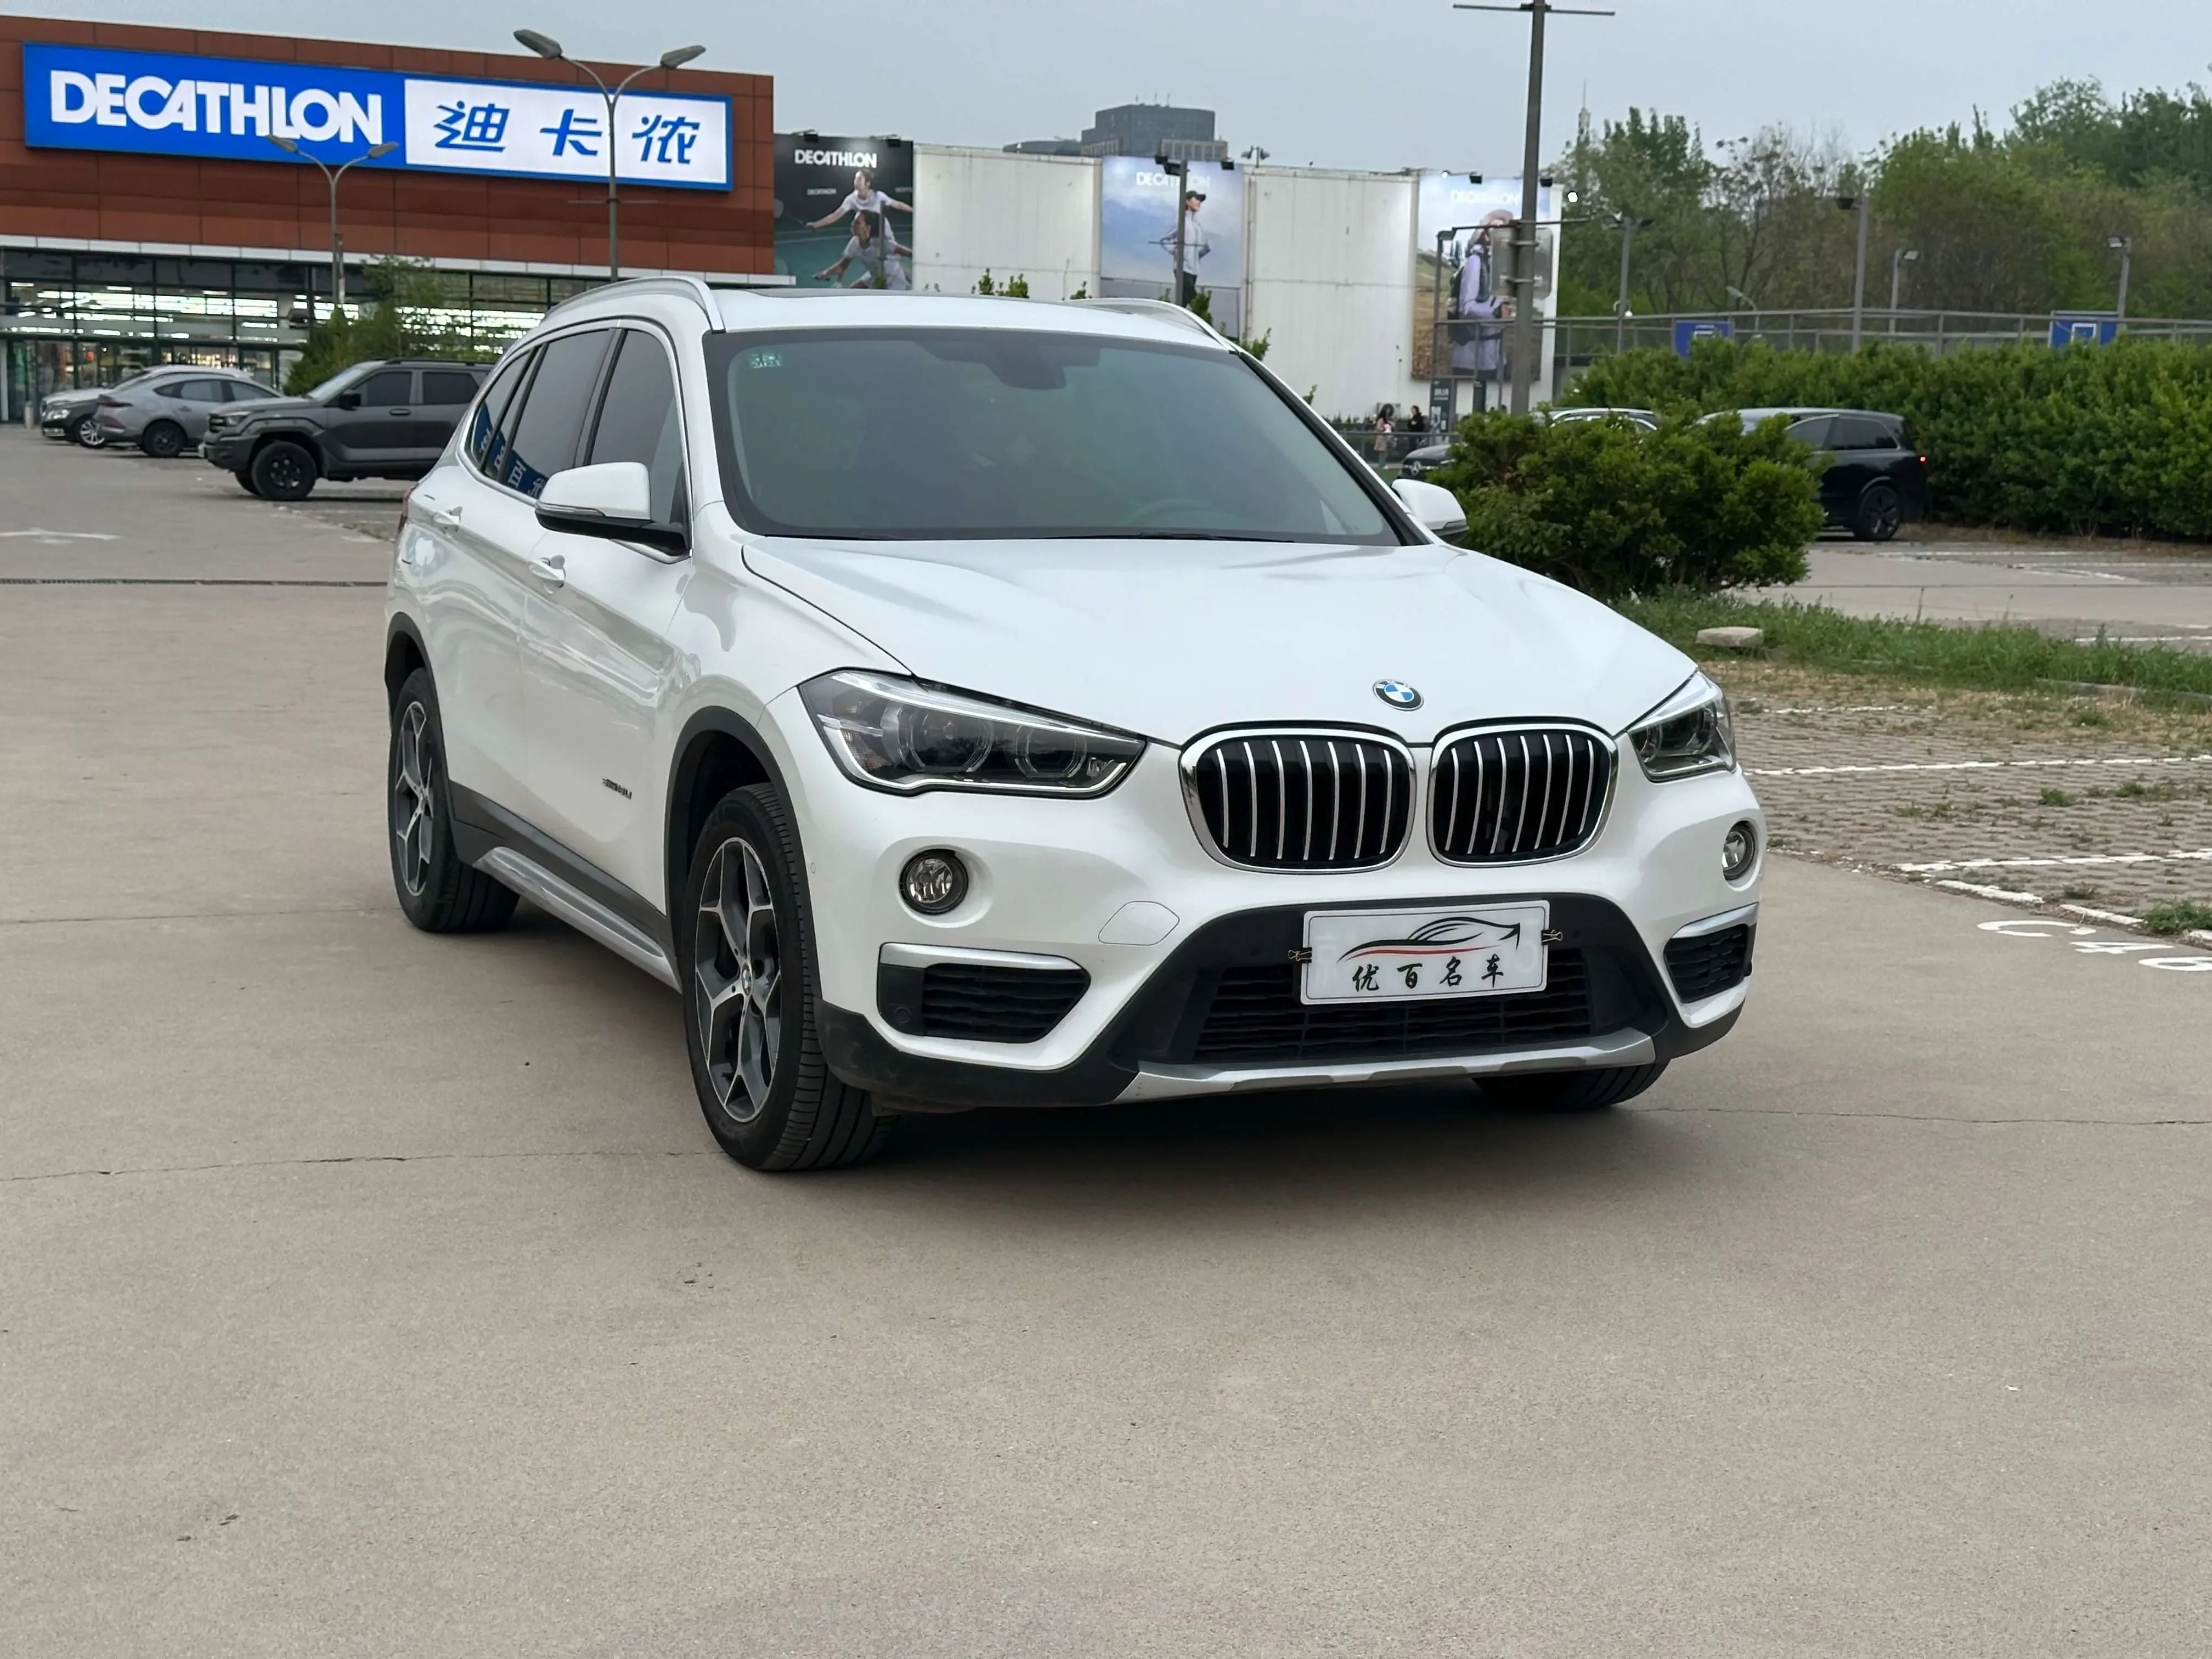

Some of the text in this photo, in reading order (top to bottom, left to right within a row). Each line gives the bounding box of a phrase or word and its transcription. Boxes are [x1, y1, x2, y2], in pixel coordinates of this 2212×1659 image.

[50, 70, 382, 145] DECATHLON
[434, 100, 700, 164] 迪卡侬
[794, 149, 877, 168] DECATHLON
[1352, 953, 1505, 992] 优百名车
